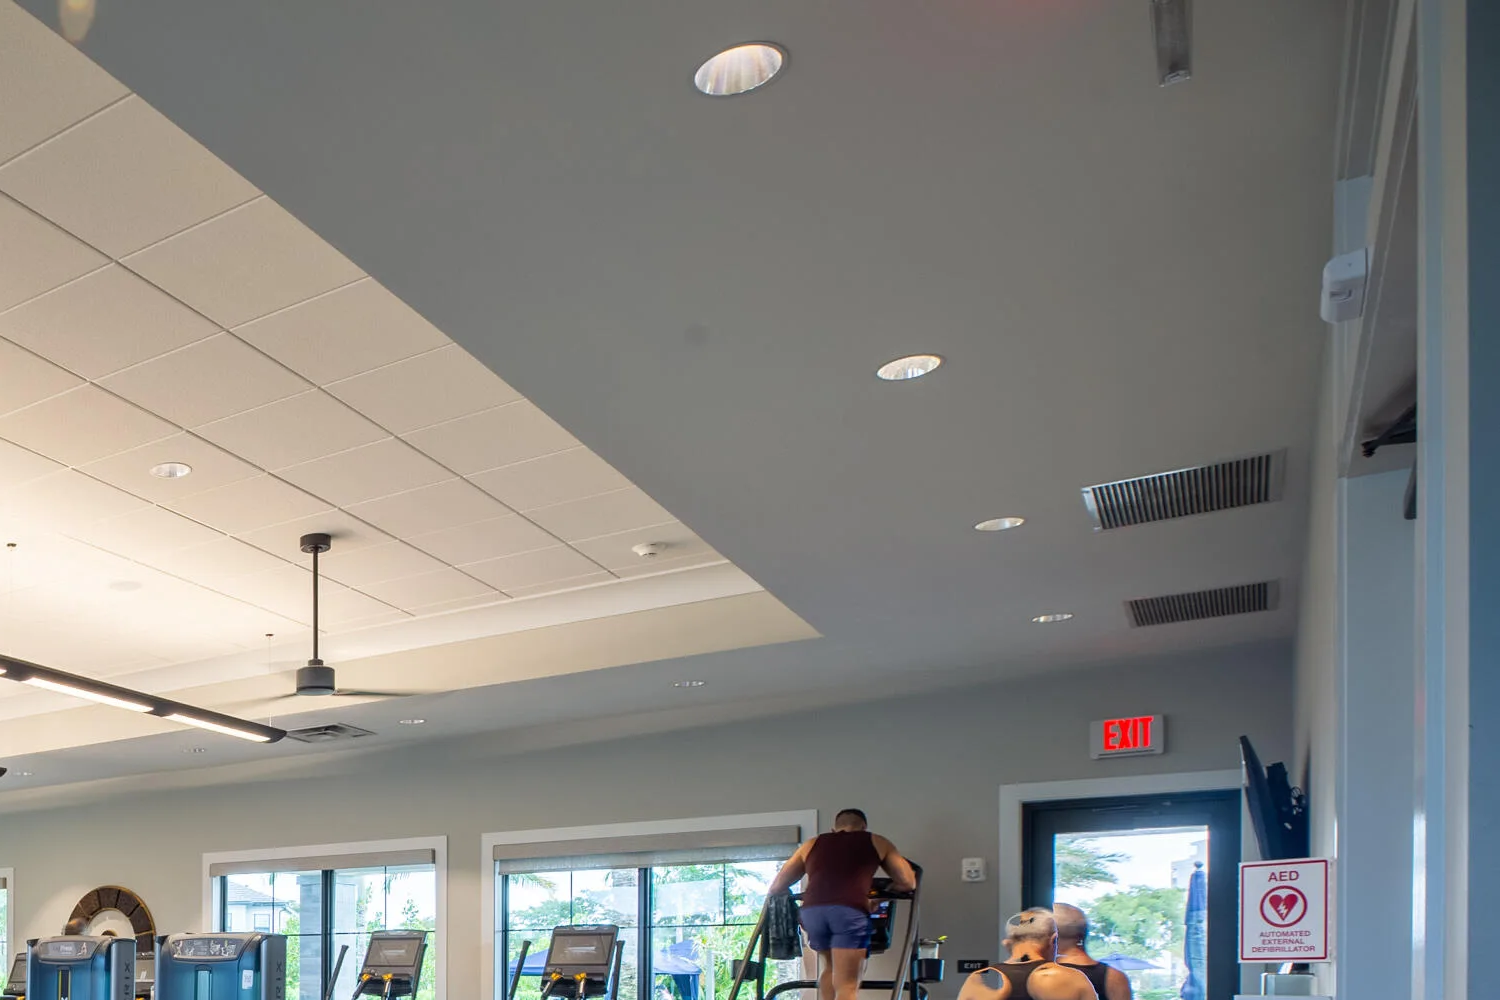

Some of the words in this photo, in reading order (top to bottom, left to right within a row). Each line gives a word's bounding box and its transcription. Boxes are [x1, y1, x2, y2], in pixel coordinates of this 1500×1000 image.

[1103, 715, 1155, 752] EXIT
[1268, 870, 1300, 882] AED
[1259, 930, 1312, 938] AUTOMATED
[1251, 945, 1316, 953] DEFIBRILLATOR
